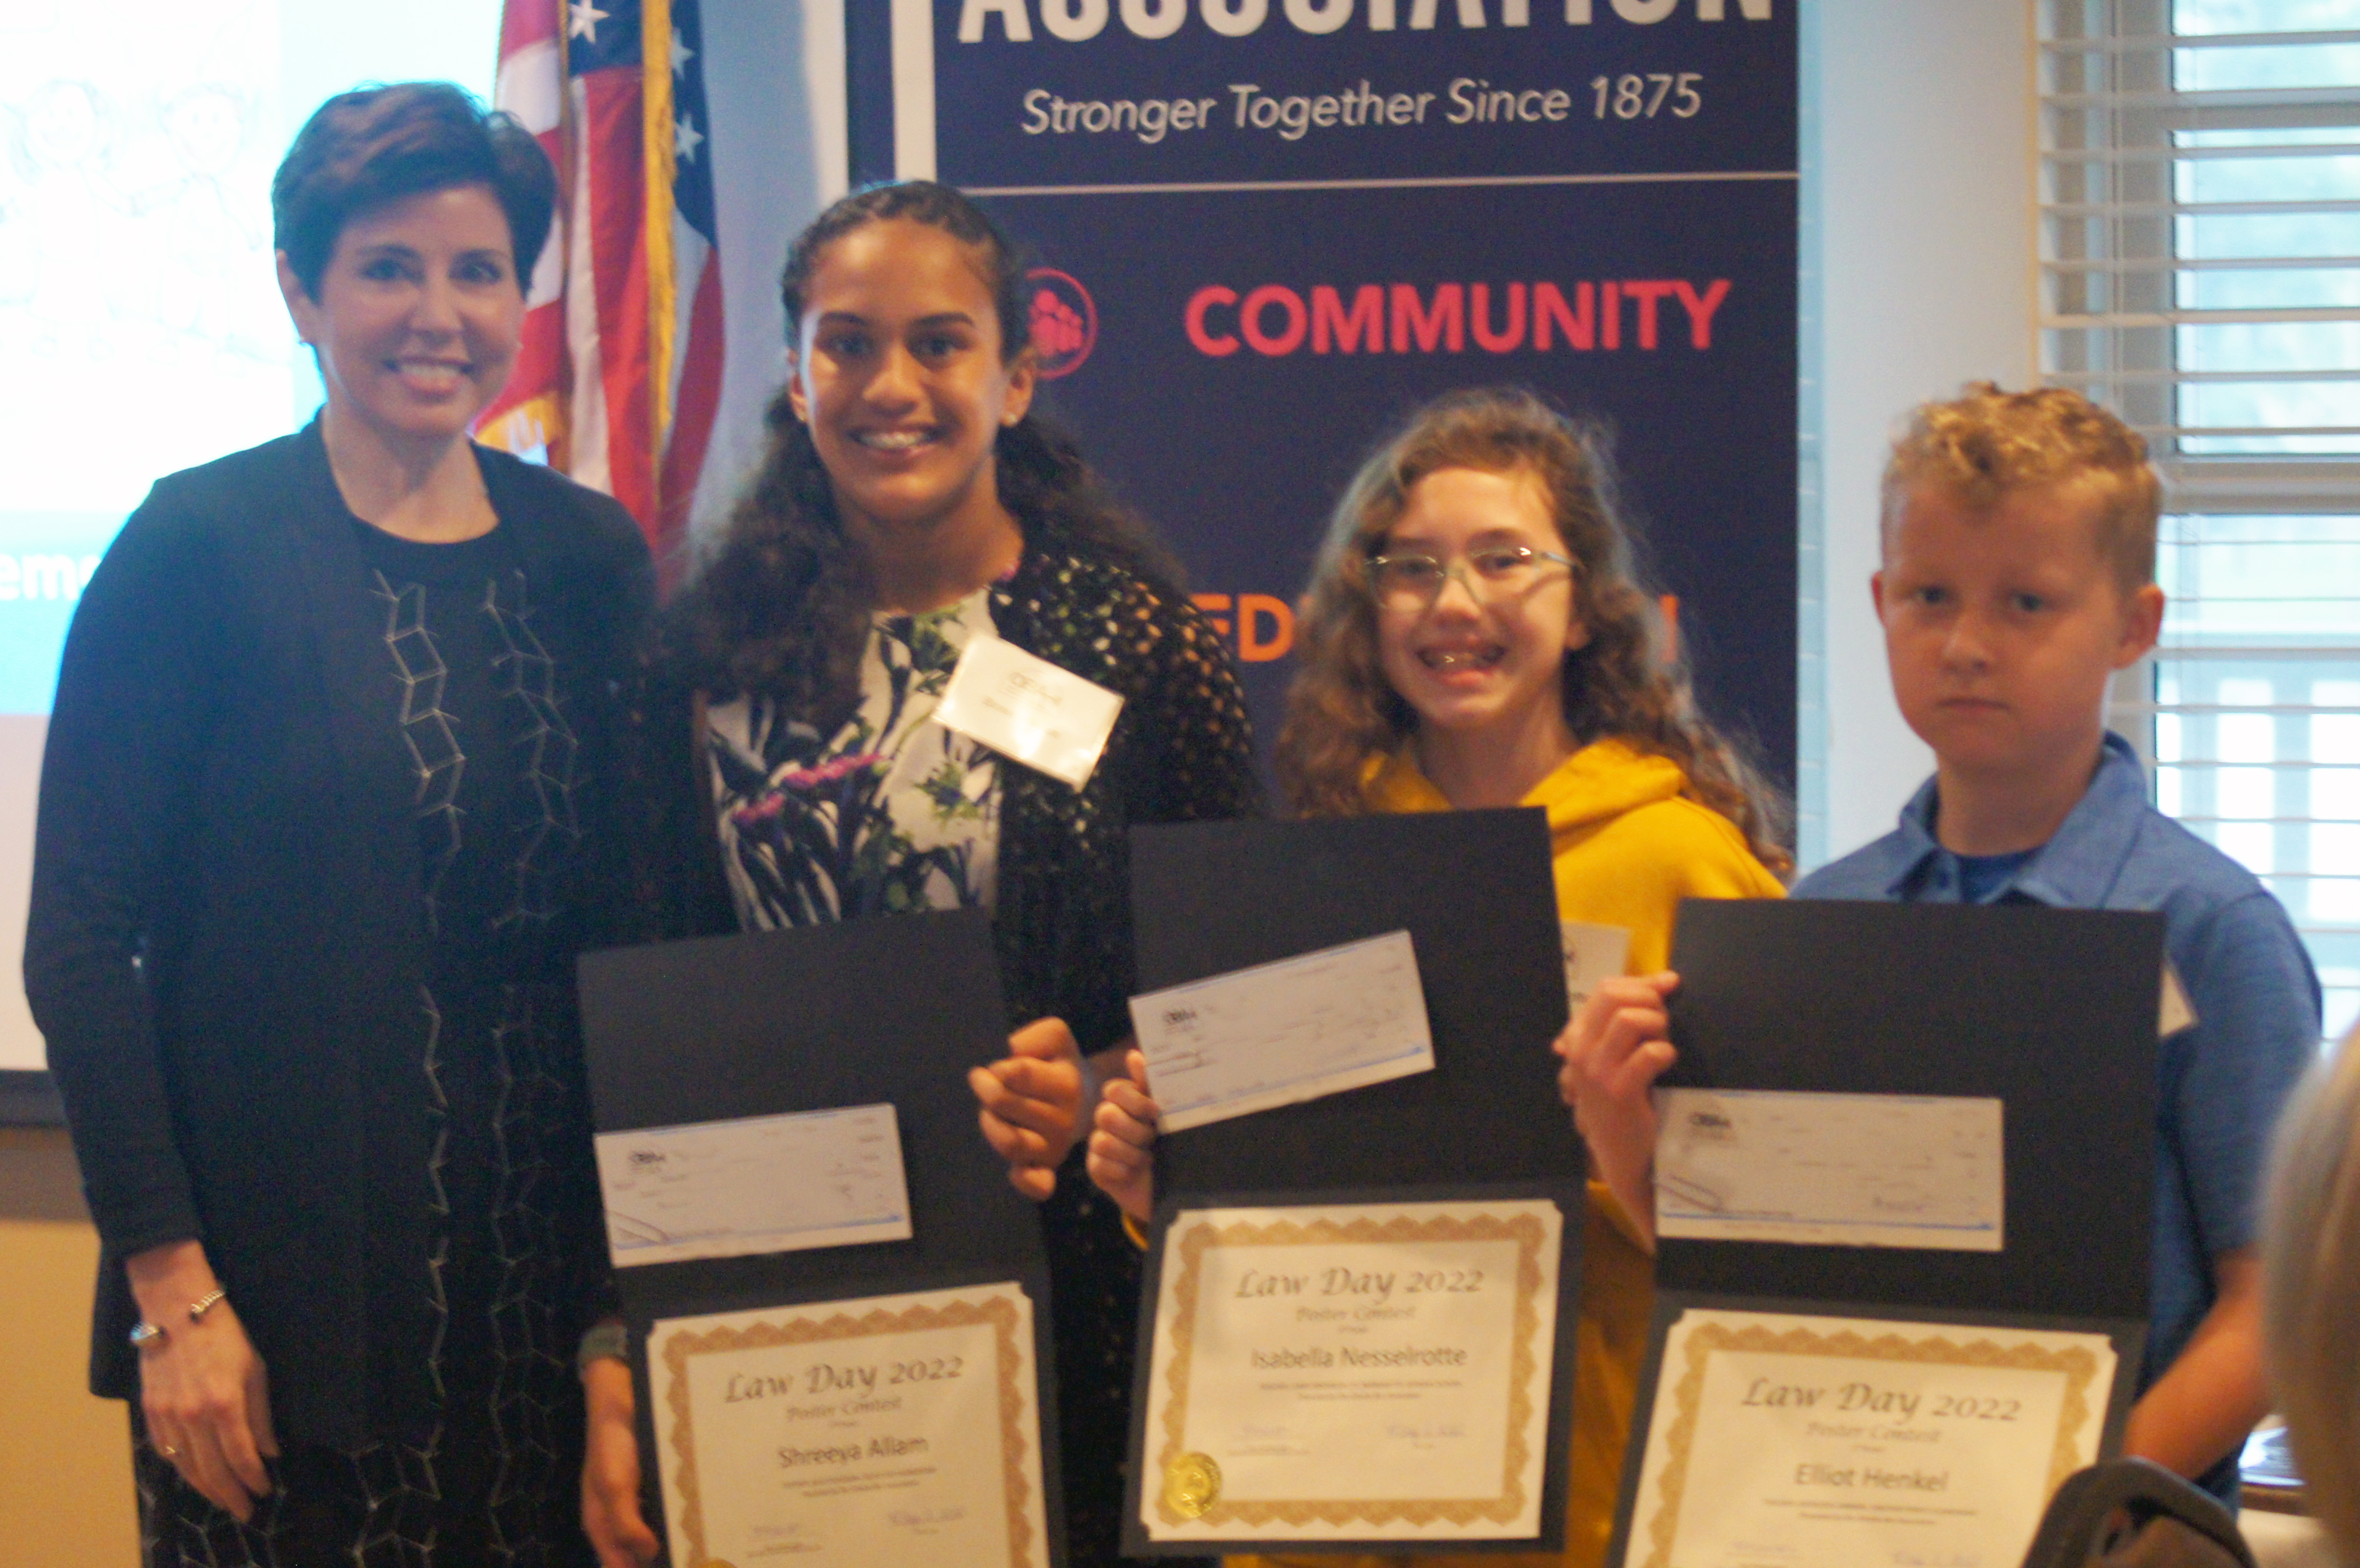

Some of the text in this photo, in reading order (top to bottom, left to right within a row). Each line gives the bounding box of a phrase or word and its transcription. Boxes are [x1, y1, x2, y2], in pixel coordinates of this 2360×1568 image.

[1020, 72, 1703, 144] Stronger Together Since 1875
[1184, 279, 1731, 356] COMMUNITY
[1234, 1267, 1484, 1305] Law Day 2022
[724, 1356, 964, 1403] Law Day 2022
[1251, 1347, 1335, 1369] Isabella
[1741, 1377, 2022, 1425] Law Day 2022
